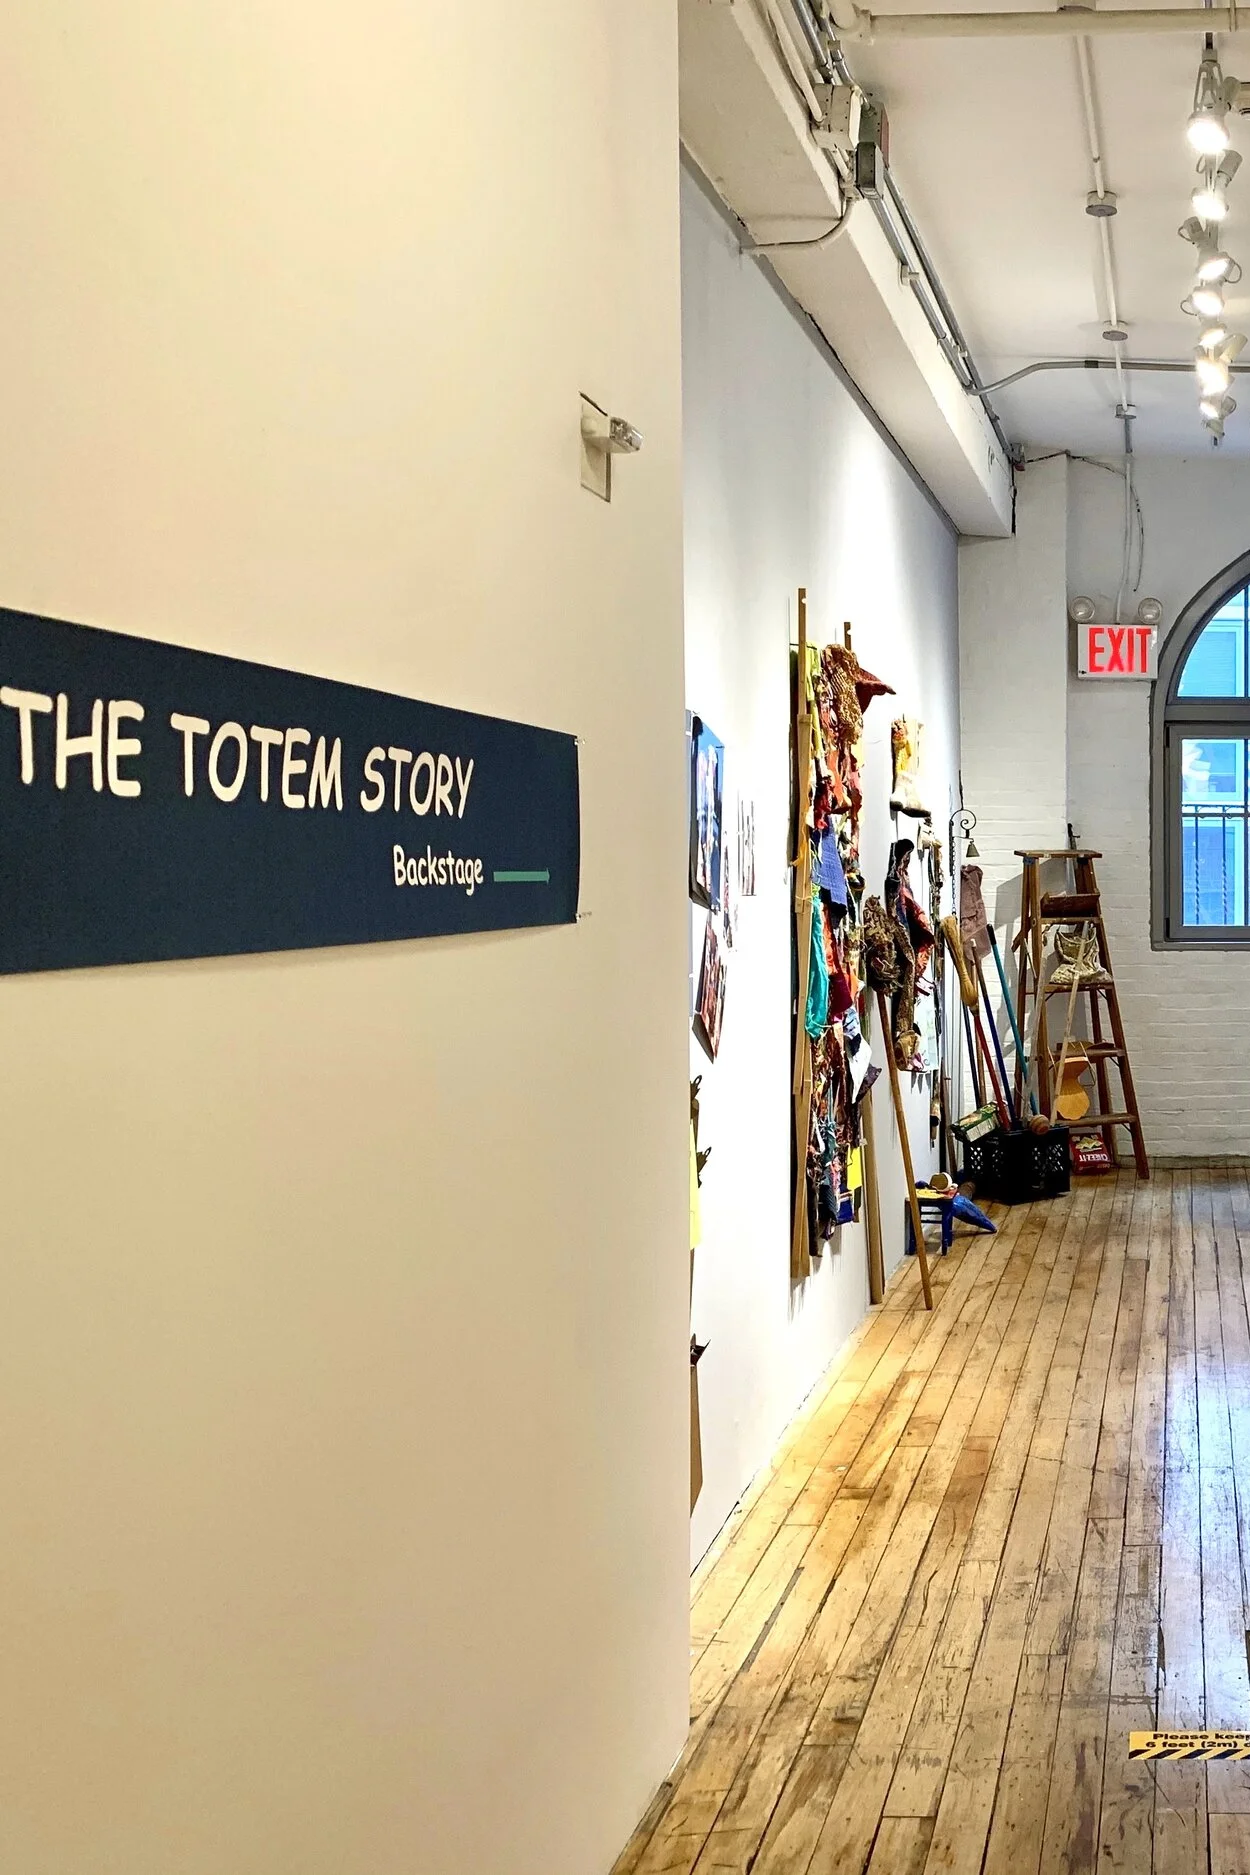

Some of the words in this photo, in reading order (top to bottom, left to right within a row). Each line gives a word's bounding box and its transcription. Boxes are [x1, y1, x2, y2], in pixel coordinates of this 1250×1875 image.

[1088, 627, 1152, 673] EXIT
[0, 686, 146, 798] THE
[170, 712, 344, 811] TOTEM
[360, 746, 474, 819] STORY
[392, 844, 485, 896] Backstage
